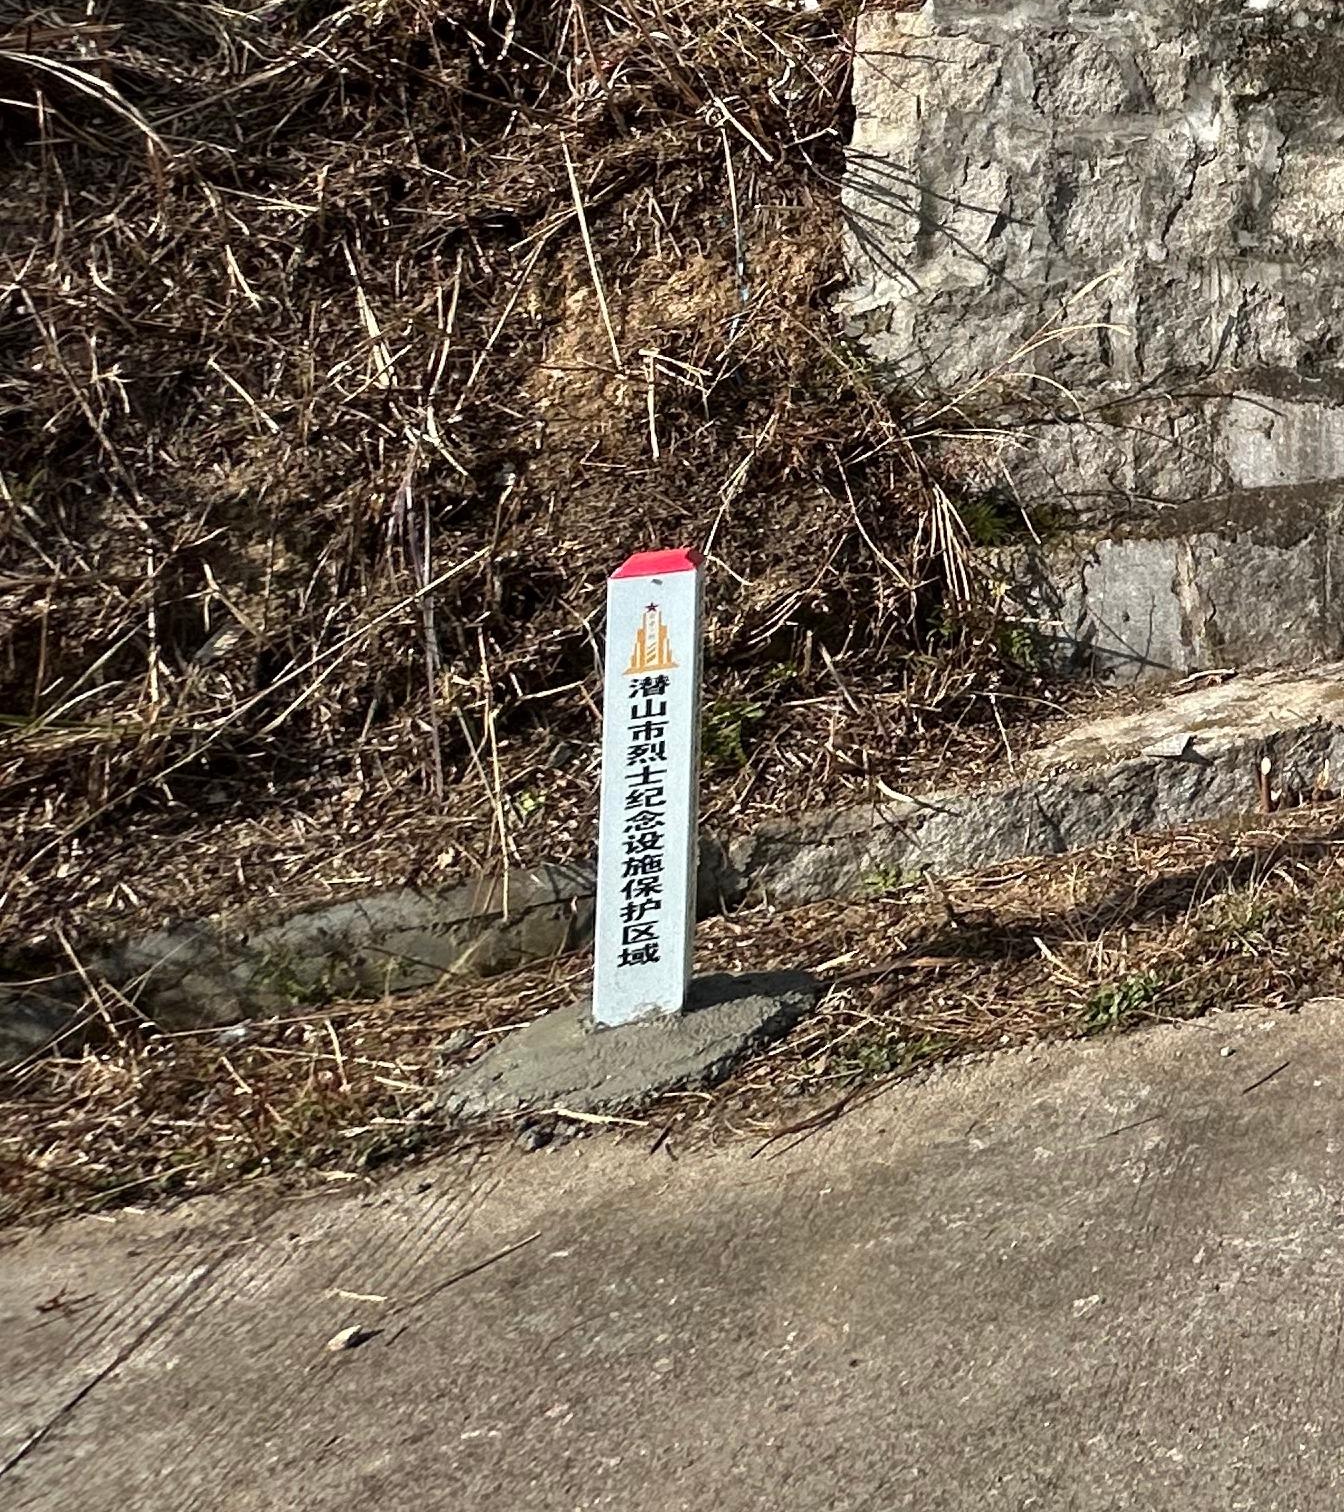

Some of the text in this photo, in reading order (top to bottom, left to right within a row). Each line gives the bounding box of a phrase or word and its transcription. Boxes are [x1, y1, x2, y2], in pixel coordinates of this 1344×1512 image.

[617, 674, 671, 967] 潜山市烈士纪念设施保护区域
